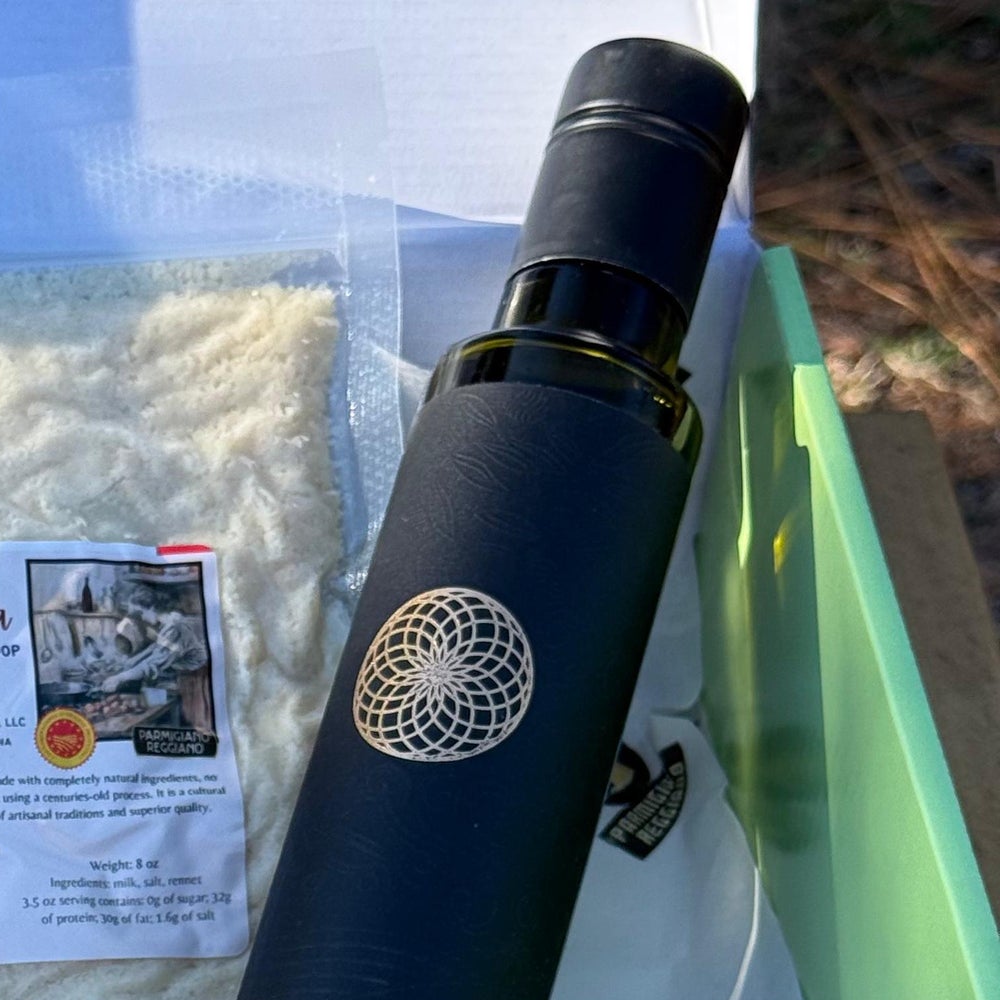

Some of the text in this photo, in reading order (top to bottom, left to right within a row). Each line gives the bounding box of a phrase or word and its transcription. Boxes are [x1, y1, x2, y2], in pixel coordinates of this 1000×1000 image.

[4, 717, 26, 728] LLC
[18, 775, 41, 785] with
[44, 775, 100, 788] completely
[104, 773, 139, 784] natural
[203, 775, 217, 783] no
[2, 793, 31, 805] using
[42, 790, 110, 803] centuries-old
[112, 791, 154, 803] process.
[156, 789, 165, 798] It
[167, 789, 176, 797] is
[187, 786, 226, 796] cultural
[8, 808, 52, 821] artisanal
[55, 807, 105, 819] traditions
[107, 807, 127, 818] and
[129, 805, 171, 817] superior
[174, 803, 212, 815] quality.
[89, 858, 159, 872] Weight: 8 oz
[113, 876, 140, 889] milk,
[168, 875, 202, 885] rennet
[22, 897, 40, 909] 3.5
[42, 897, 56, 906] oz
[58, 896, 96, 908] serving
[163, 893, 175, 903] of
[211, 893, 232, 905] 32g
[41, 913, 54, 925] of
[101, 914, 119, 926] 30g
[121, 912, 133, 924] of
[156, 912, 179, 925] 1.6g
[181, 912, 194, 922] of
[196, 911, 215, 921] salt
